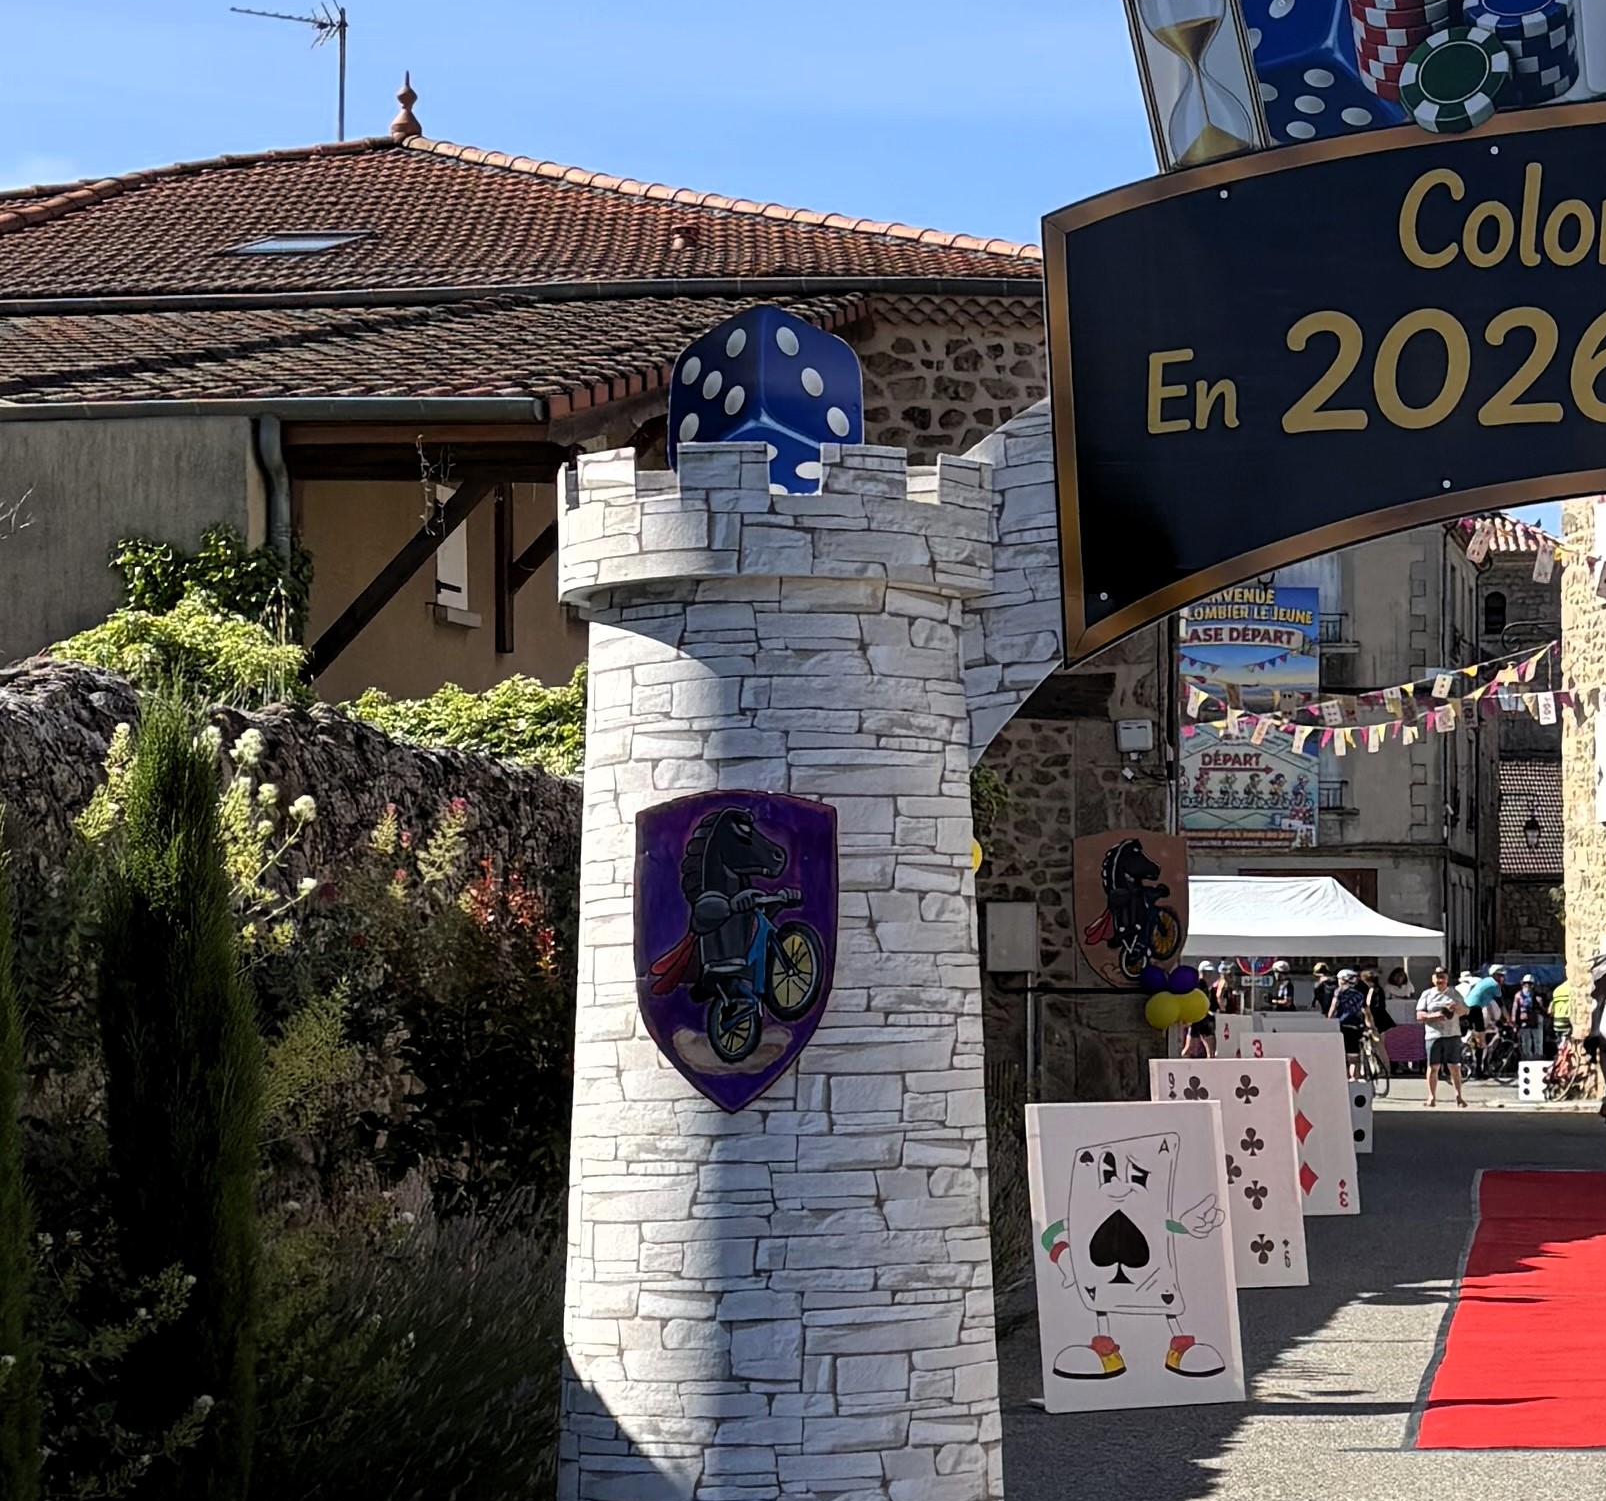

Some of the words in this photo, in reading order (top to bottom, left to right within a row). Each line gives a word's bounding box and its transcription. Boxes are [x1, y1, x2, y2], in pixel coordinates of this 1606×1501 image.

[1148, 348, 1240, 434] En
[1253, 605, 1269, 620] LE
[1271, 606, 1313, 625] JEUNE
[1183, 627, 1223, 644] ASE
[1229, 624, 1295, 646] DÉPART
[1201, 750, 1262, 766] DÉPART
[1252, 1039, 1264, 1058] 3
[1168, 1072, 1176, 1090] 9
[1158, 1138, 1170, 1154] A
[1339, 1191, 1349, 1208] 3
[1084, 1286, 1097, 1302] A
